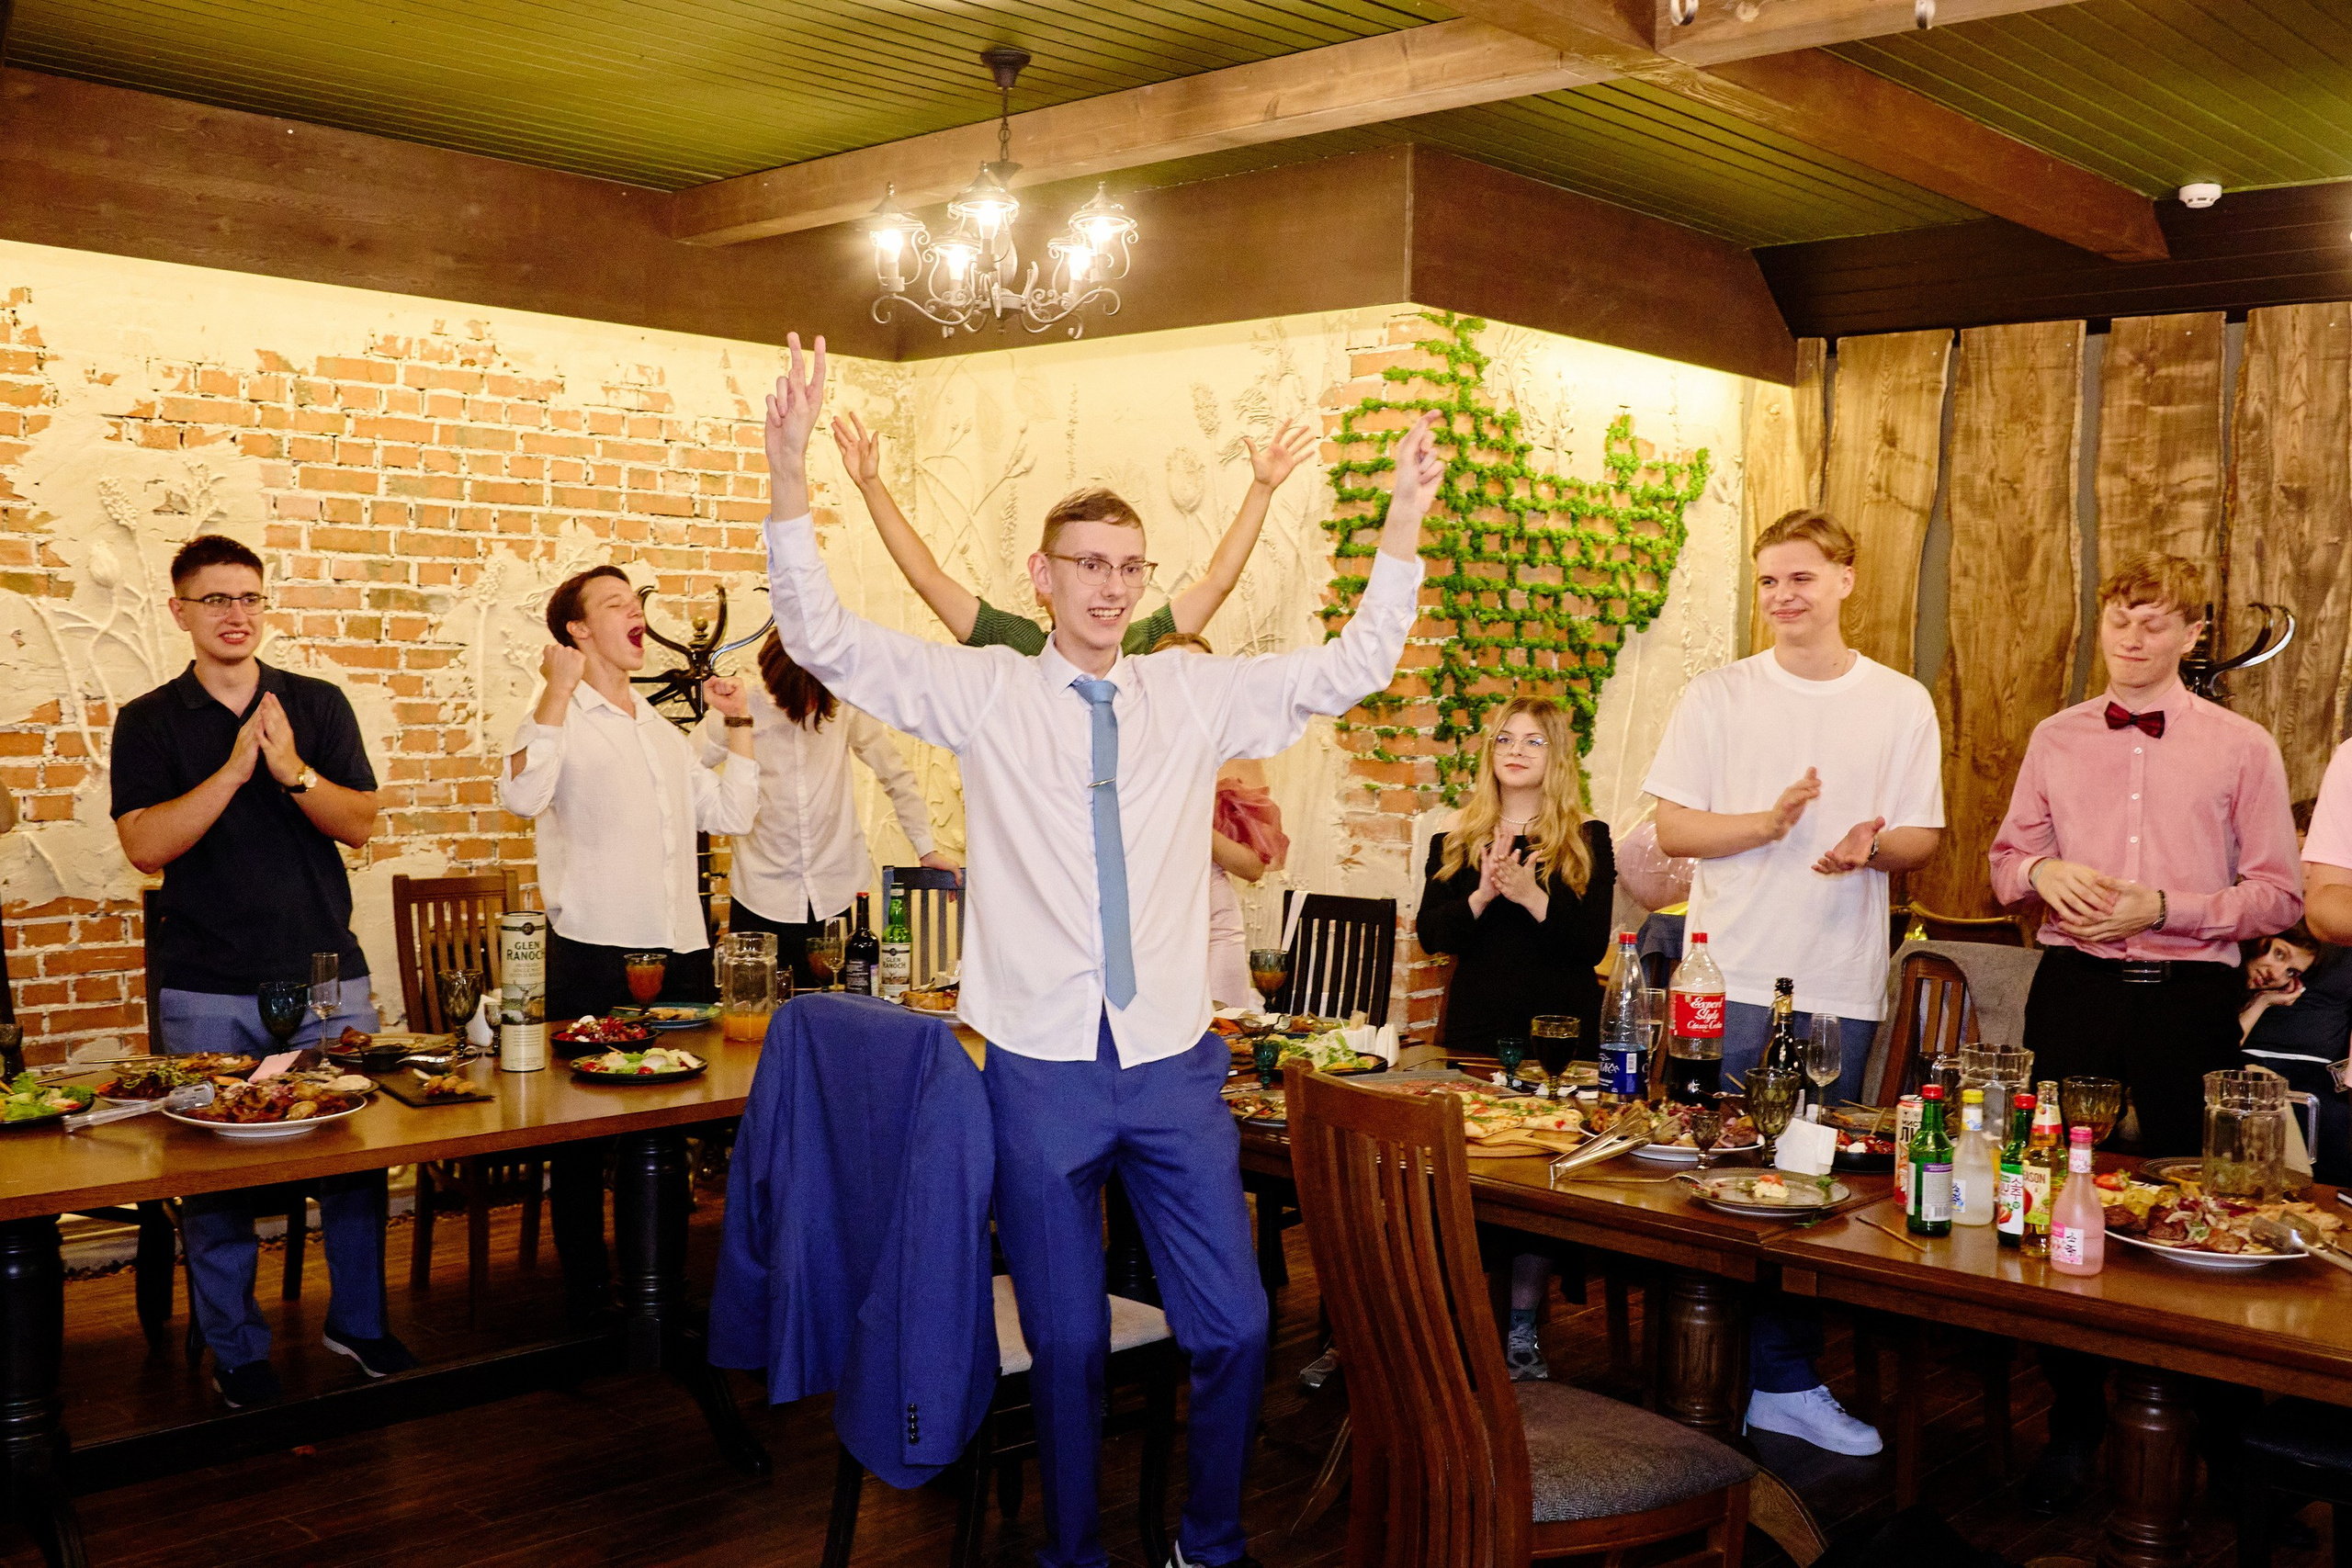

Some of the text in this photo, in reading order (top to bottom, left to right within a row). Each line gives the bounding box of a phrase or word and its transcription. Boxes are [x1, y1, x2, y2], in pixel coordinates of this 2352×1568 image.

[514, 942, 540, 951] GLEN
[1694, 1009, 1720, 1023] Style
[1709, 1020, 1724, 1029] Cola
[2010, 1178, 2024, 1200] 소주
